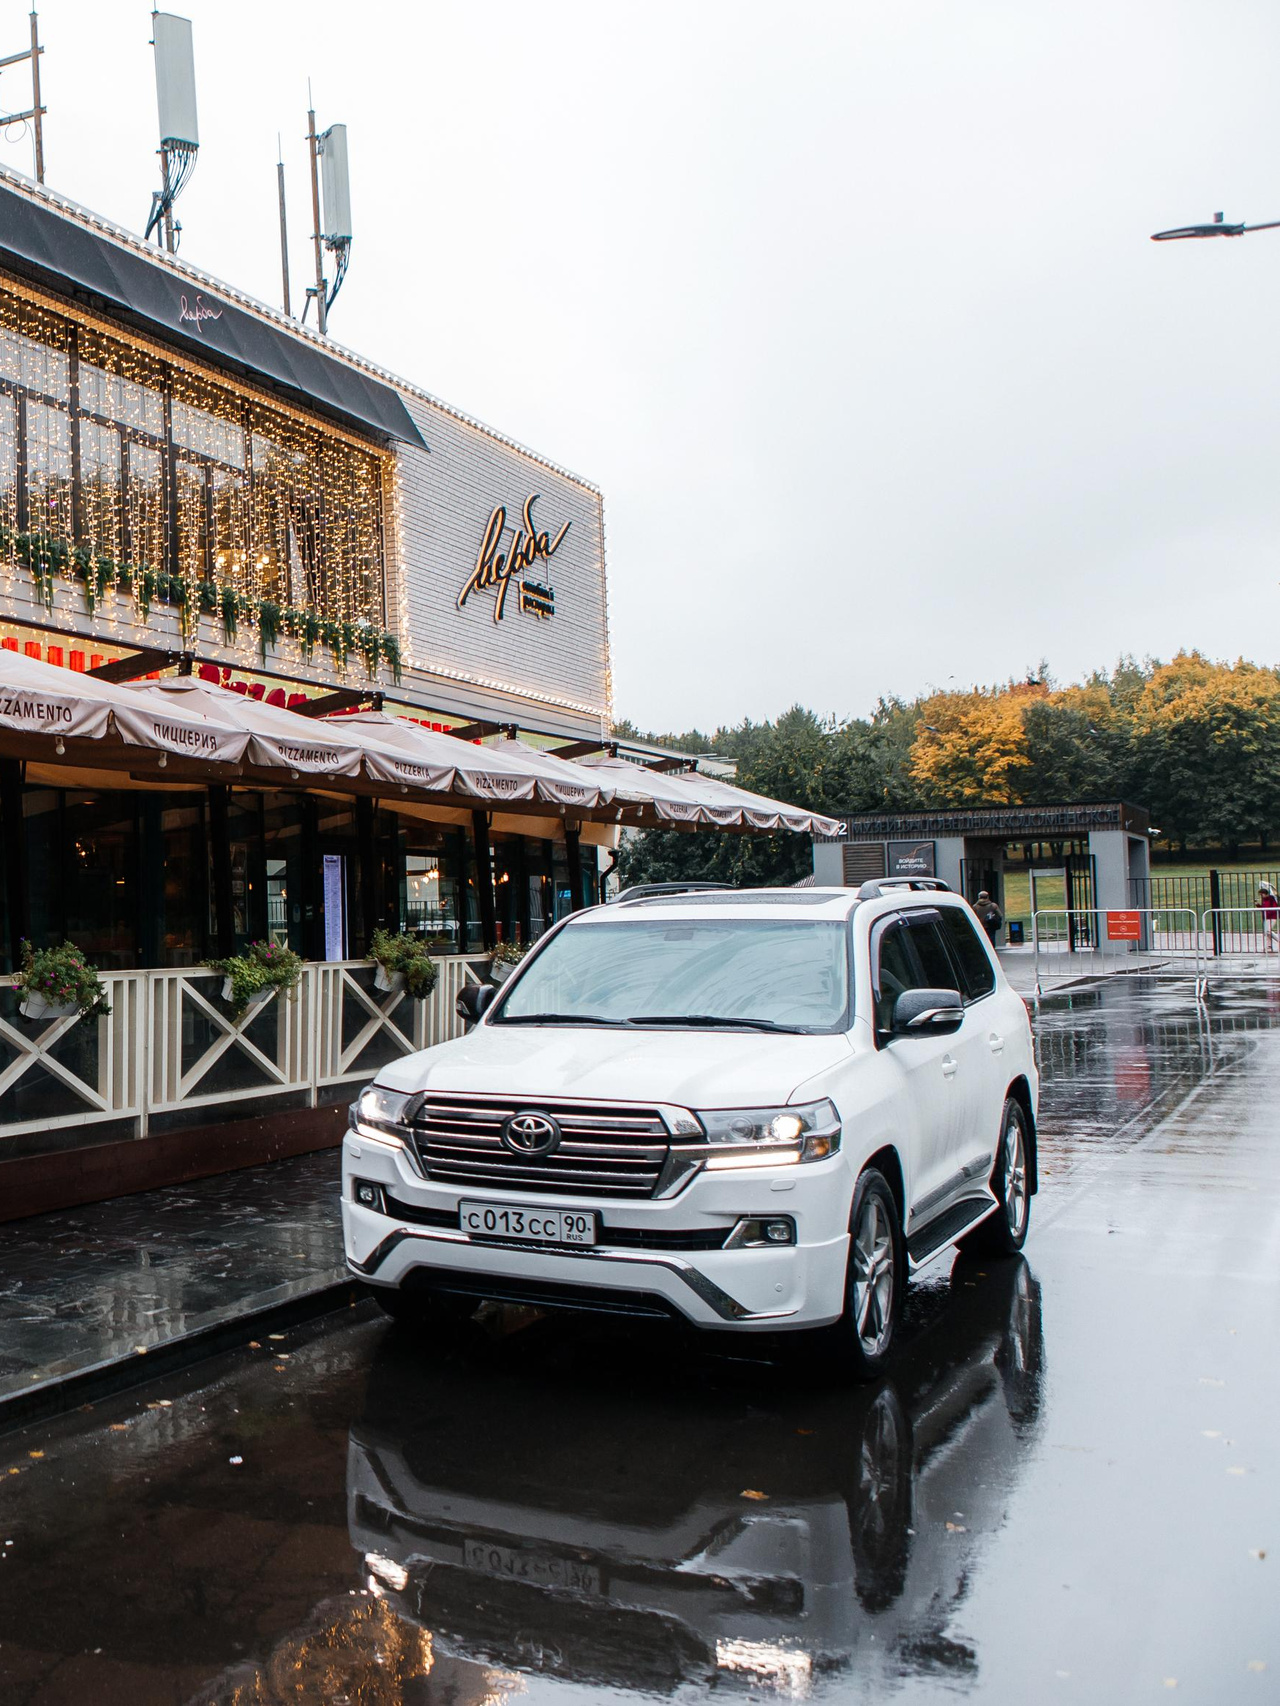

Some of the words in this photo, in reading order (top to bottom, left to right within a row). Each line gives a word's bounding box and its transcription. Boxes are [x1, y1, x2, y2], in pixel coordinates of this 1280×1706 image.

[153, 722, 218, 750] ПИЦЦЕРИЯ
[277, 745, 339, 765] PIZZAMENTO
[394, 760, 432, 780] PIZZERIA
[475, 777, 518, 792] PIZZAMENTO
[555, 784, 586, 798] ПИЦЦЕРИЯ
[838, 822, 848, 836] 2
[564, 1215, 586, 1233] 90
[566, 1233, 584, 1241] RUS
